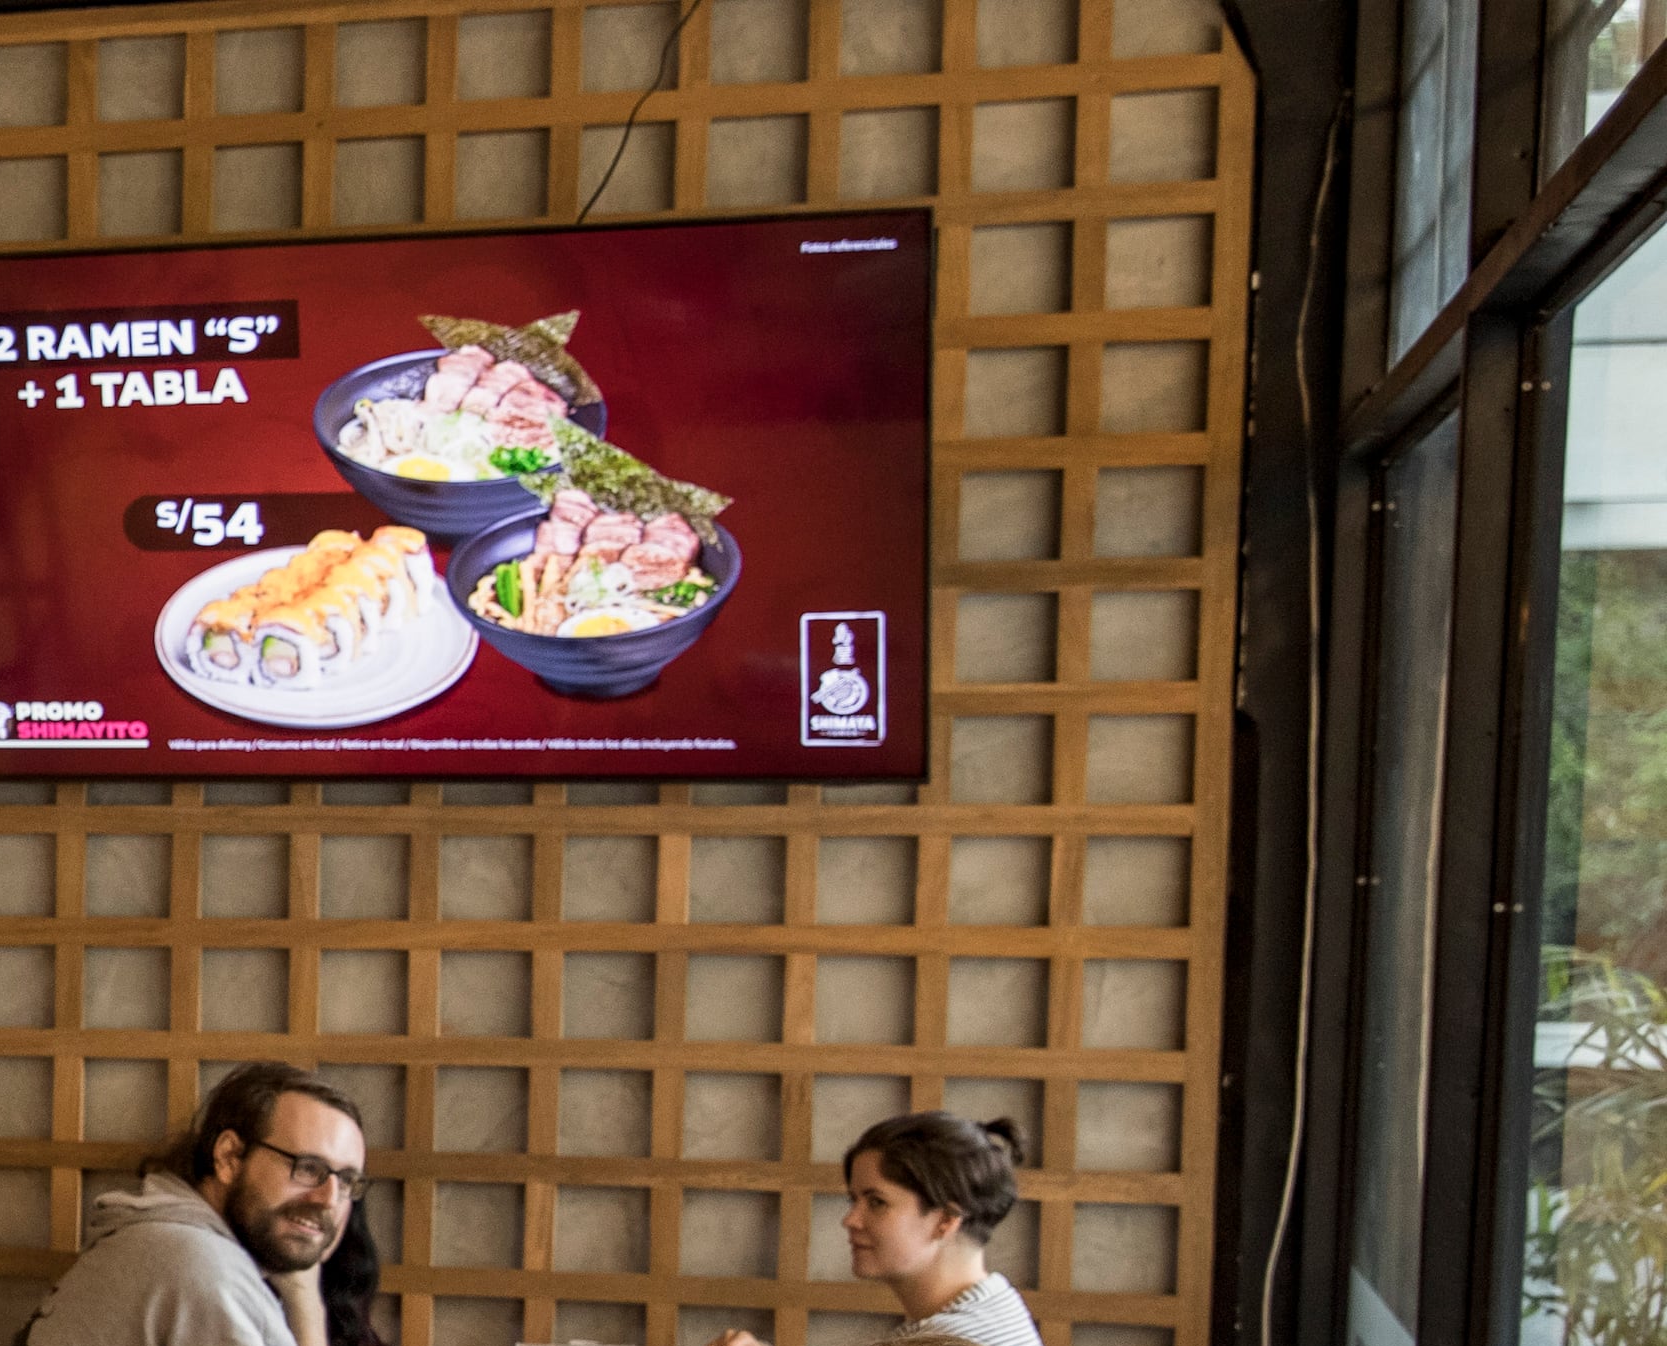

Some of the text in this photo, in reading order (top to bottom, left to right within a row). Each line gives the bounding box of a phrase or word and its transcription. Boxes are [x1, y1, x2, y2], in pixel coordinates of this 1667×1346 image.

[26, 319, 195, 361] RAMEN
[17, 367, 249, 409] + 1 TABLA
[15, 701, 104, 721] PROMO
[17, 720, 149, 739] SHIMAYITO
